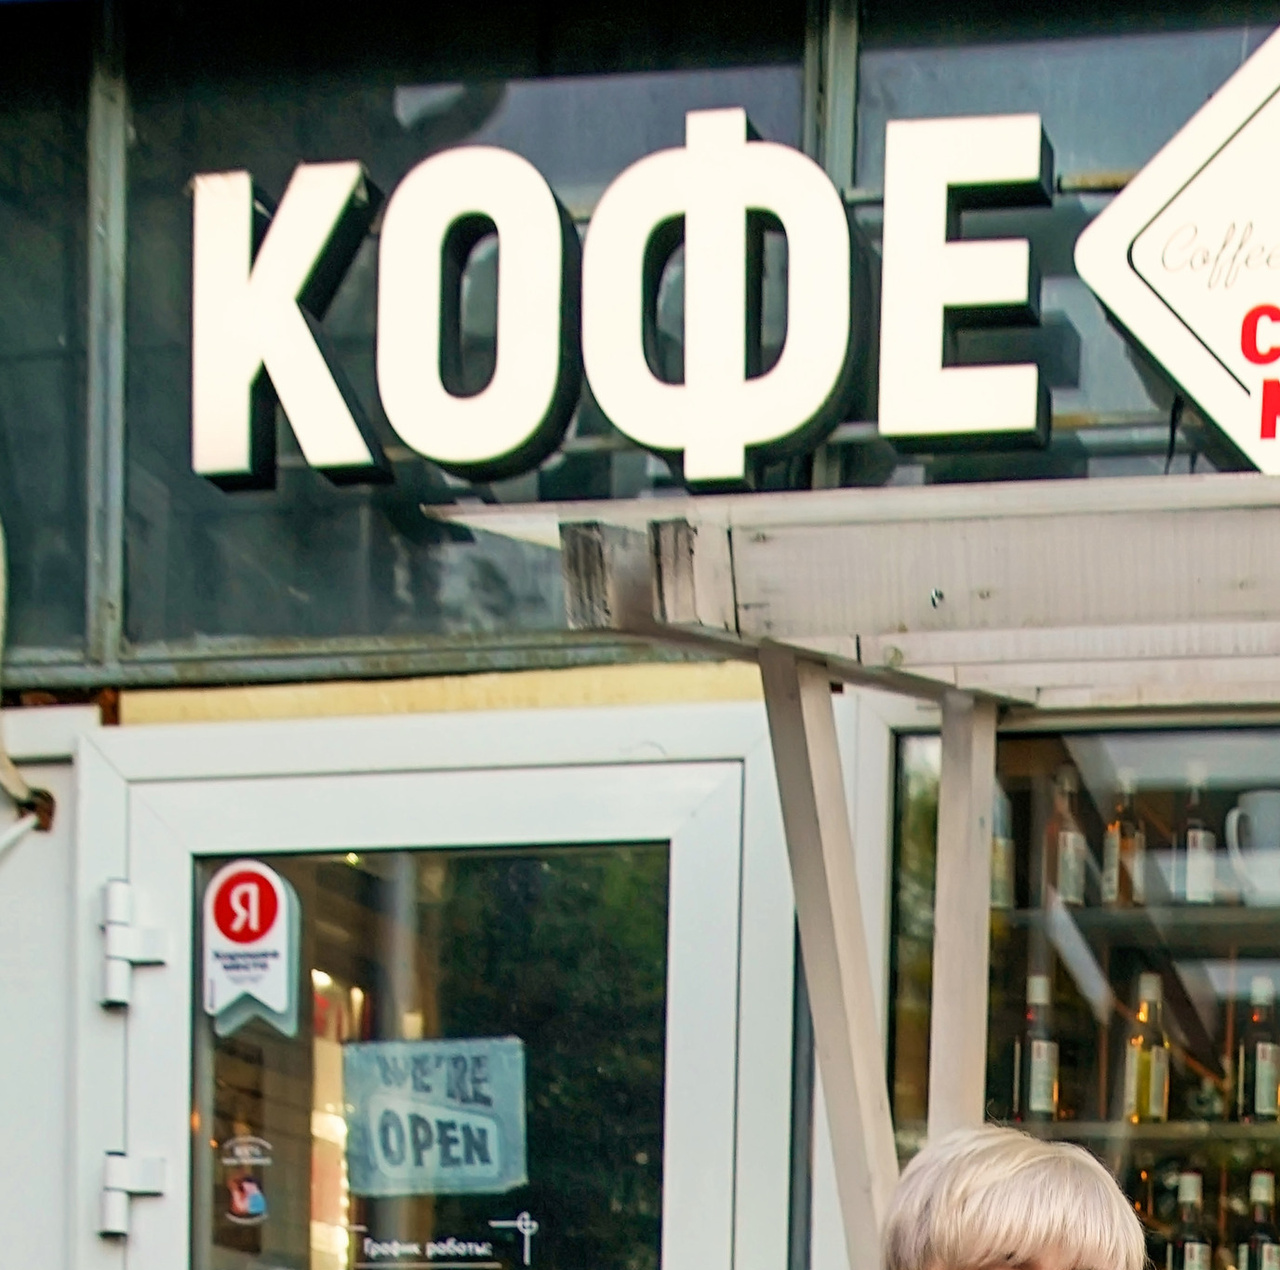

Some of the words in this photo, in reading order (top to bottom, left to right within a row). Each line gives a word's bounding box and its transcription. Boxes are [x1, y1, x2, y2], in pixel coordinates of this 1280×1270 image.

[190, 107, 1046, 484] КОФЕ
[230, 882, 260, 933] Я
[375, 1054, 492, 1107] WE'RE
[379, 1109, 491, 1168] OPEN
